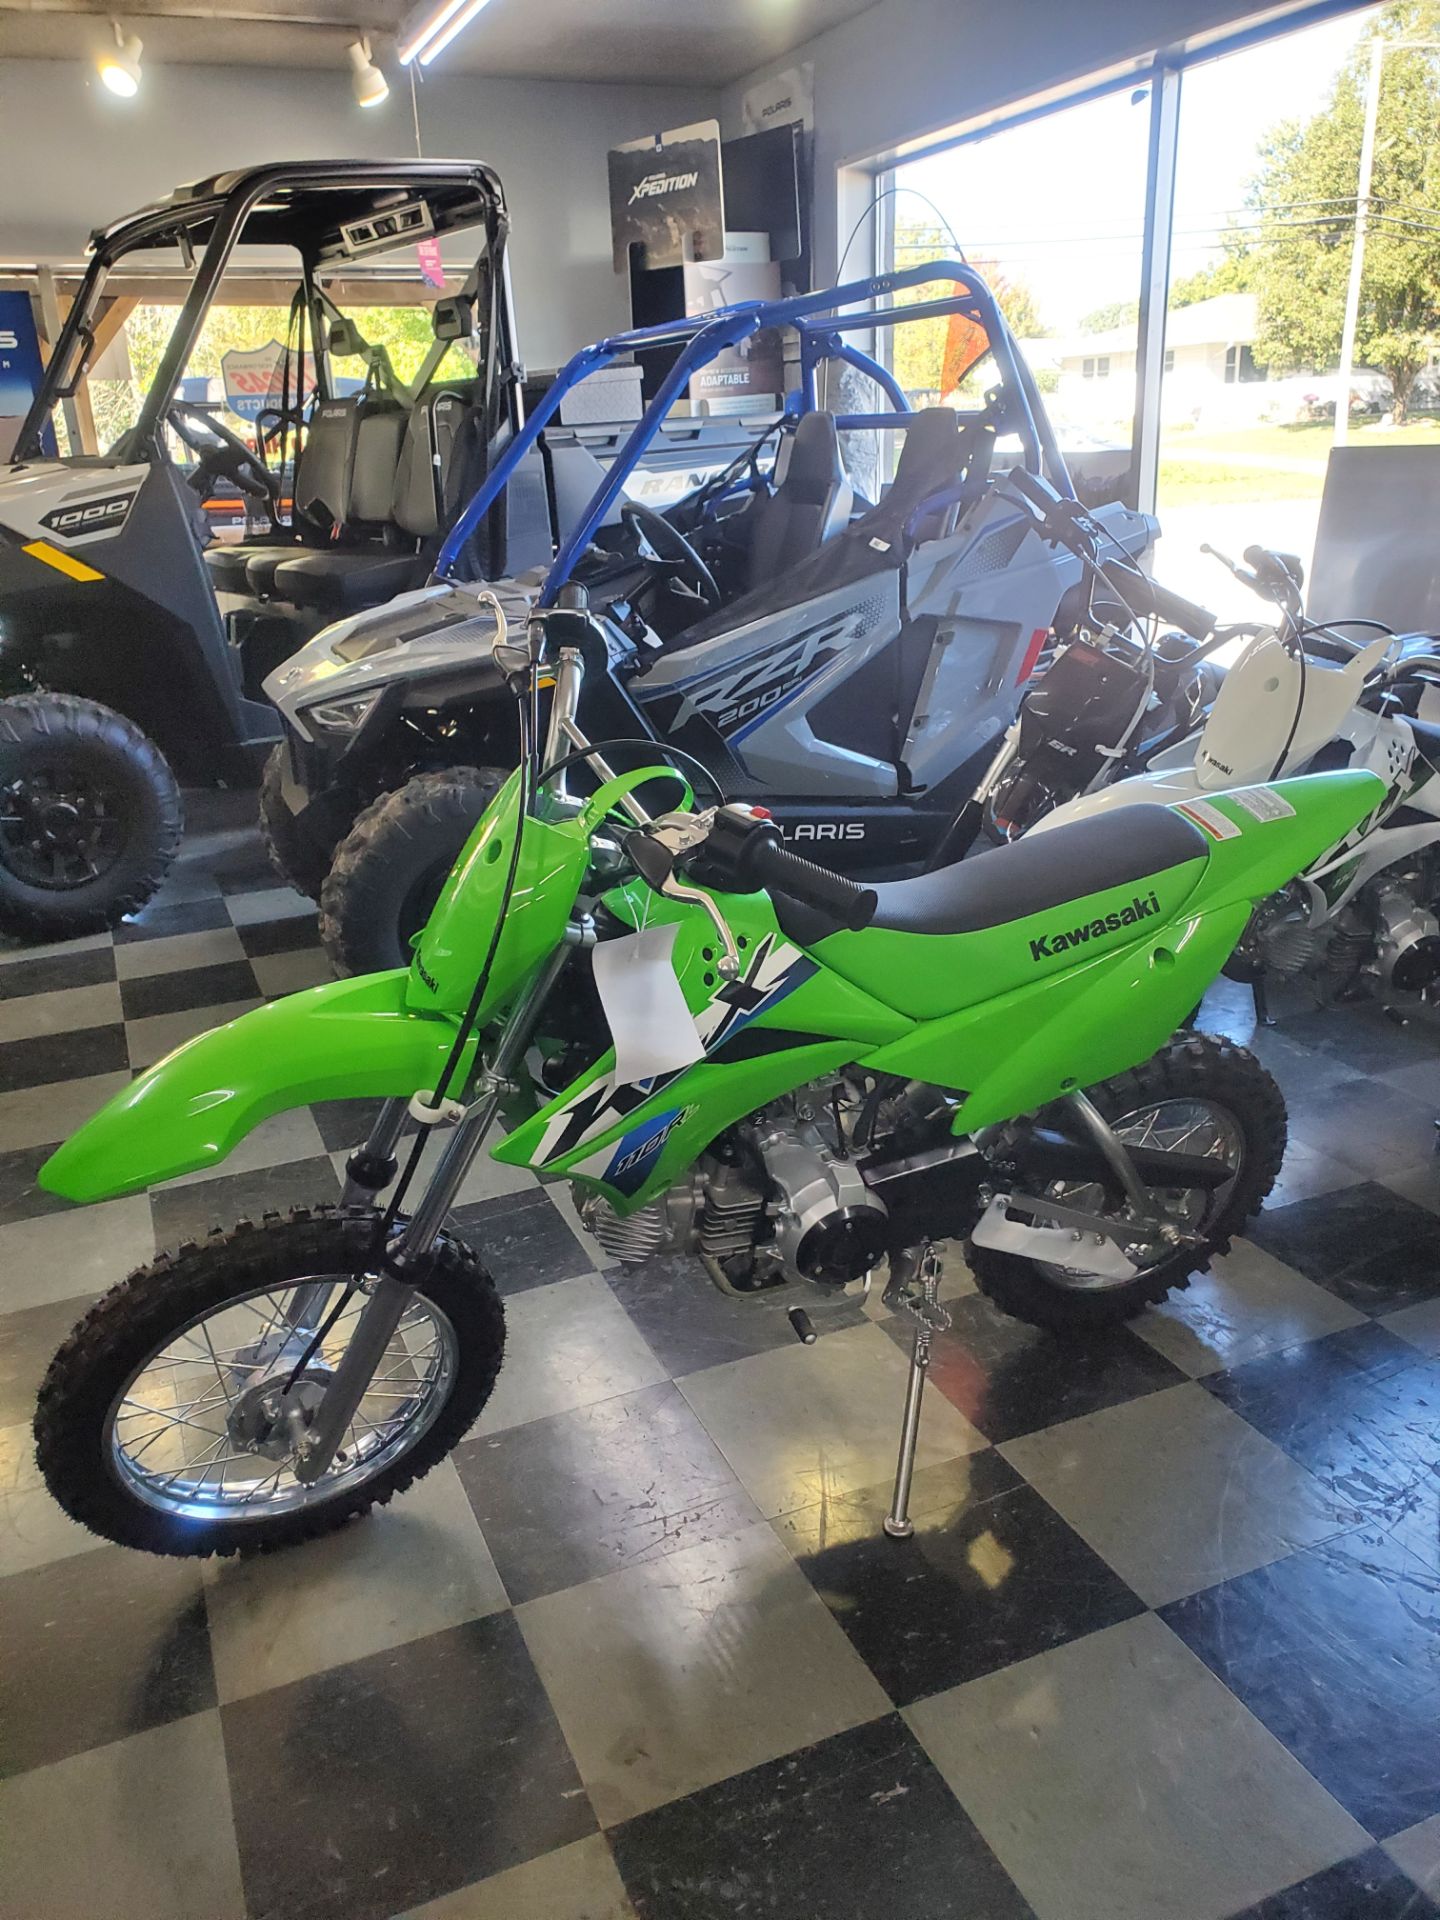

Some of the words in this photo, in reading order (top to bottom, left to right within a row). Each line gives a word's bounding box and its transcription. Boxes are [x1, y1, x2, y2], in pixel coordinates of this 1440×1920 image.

[628, 171, 699, 206] XPEDITION
[700, 373, 750, 387] ADAPTABLE
[51, 499, 129, 529] 1000
[668, 613, 863, 734] RZR
[718, 687, 782, 728] 200
[780, 823, 865, 841] LARIS
[1029, 891, 1161, 962] Kawasaki
